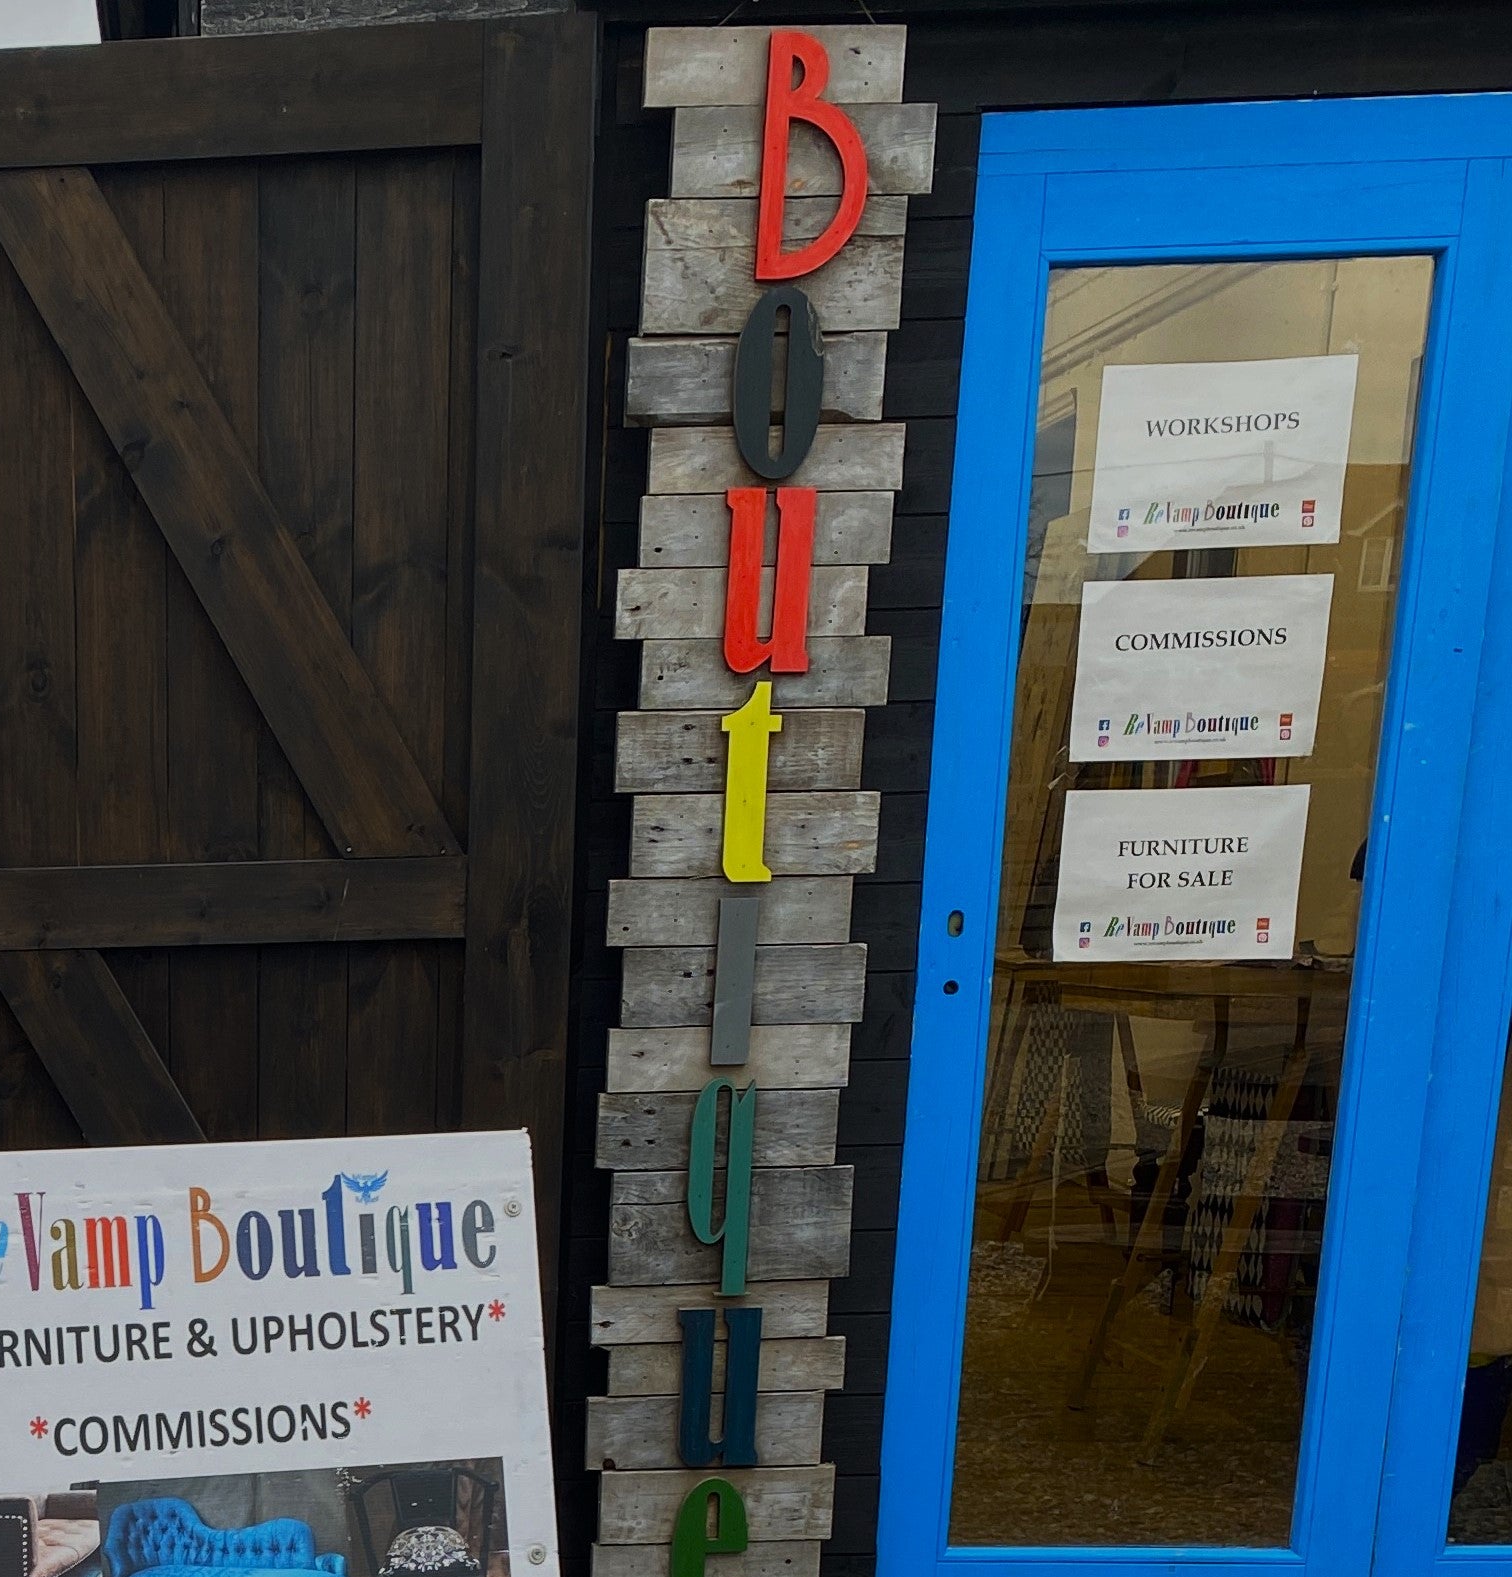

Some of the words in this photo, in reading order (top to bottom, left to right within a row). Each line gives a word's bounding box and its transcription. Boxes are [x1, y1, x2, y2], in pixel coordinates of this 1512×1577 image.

[1146, 411, 1301, 437] WORKSHOPS
[1143, 502, 1199, 527] ReVamp
[1203, 500, 1280, 523] Boutique
[1115, 627, 1287, 651] COMMISSIONS
[1123, 713, 1181, 738] ReVamp
[1184, 712, 1259, 733] Boutique
[1117, 836, 1249, 857] FURNITURE
[1126, 872, 1171, 889] FOR
[1176, 870, 1234, 889] SALE
[1103, 916, 1160, 940] ReVamp
[1164, 915, 1236, 938] Boutique
[190, 1171, 496, 1295] Boutique
[187, 1318, 217, 1357] &
